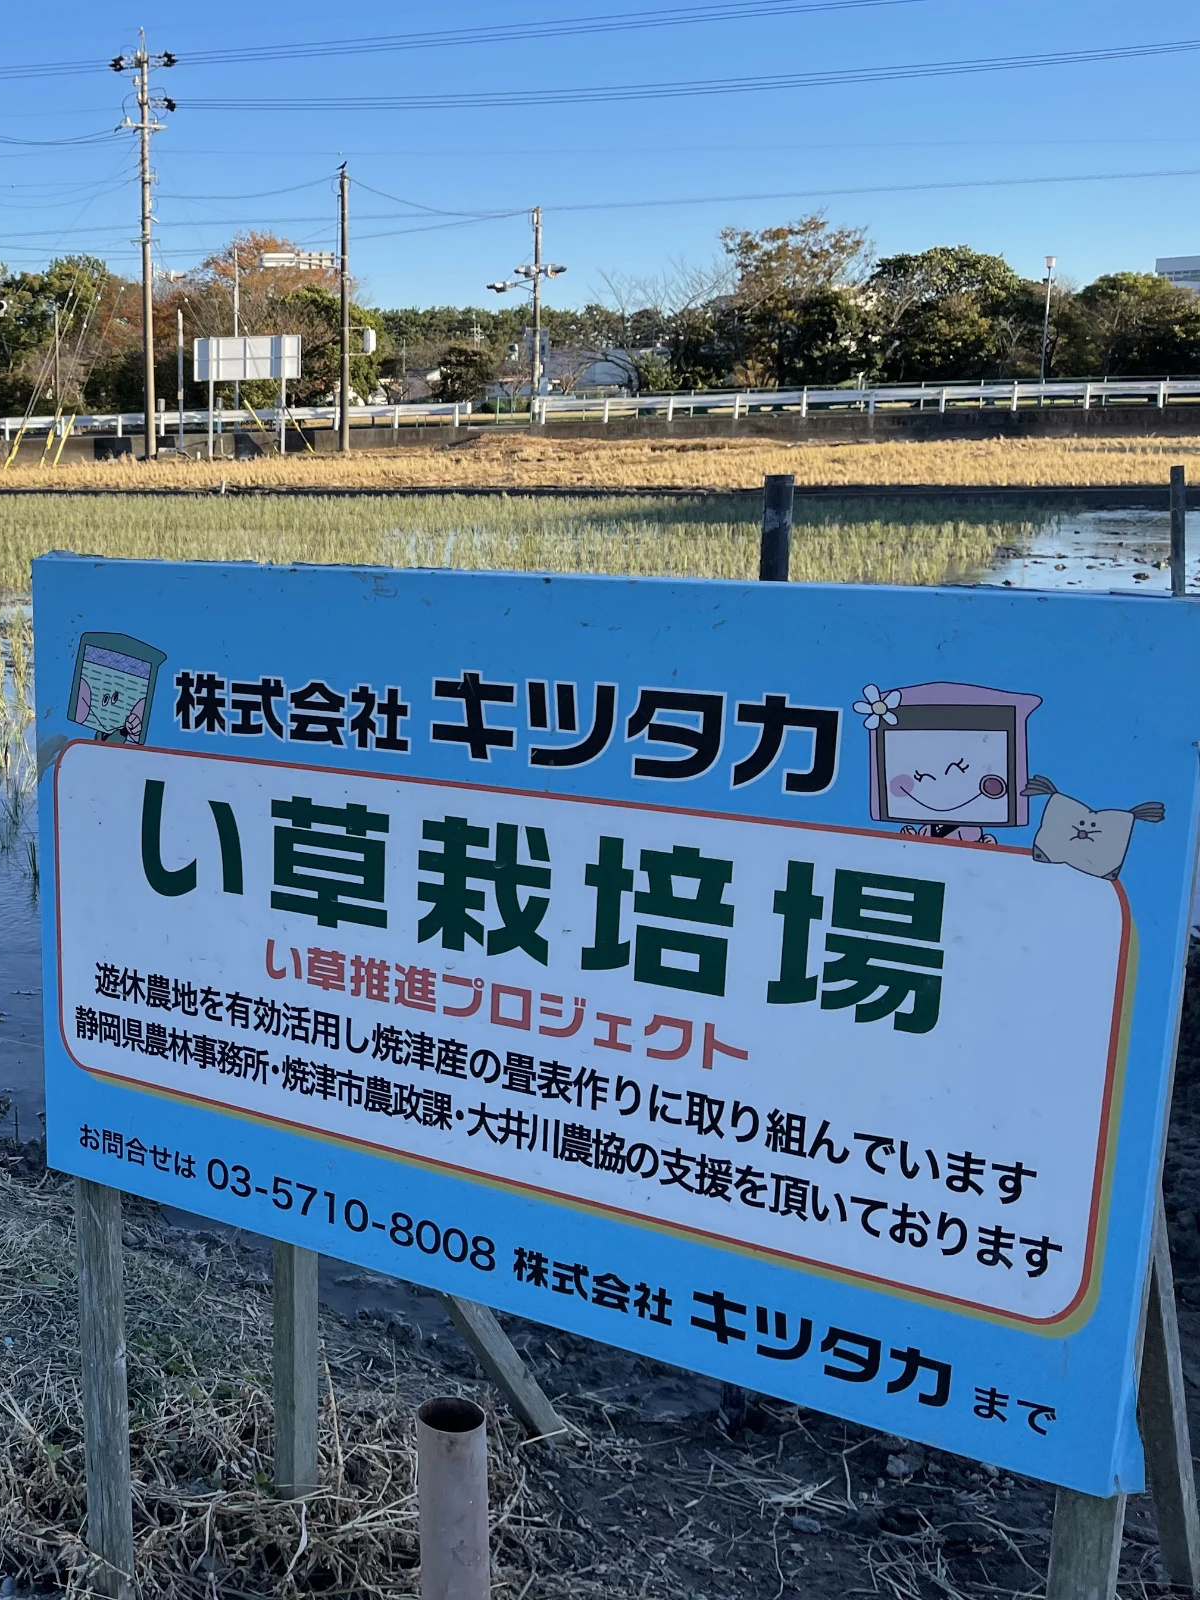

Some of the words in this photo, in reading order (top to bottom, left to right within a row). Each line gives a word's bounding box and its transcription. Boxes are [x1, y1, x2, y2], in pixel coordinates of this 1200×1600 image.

[175, 672, 410, 750] 株式会社
[432, 672, 838, 792] キツタカ
[141, 779, 945, 1033] い草栽培場
[266, 939, 749, 1070] い草推進プロジェクト
[95, 963, 1038, 1204] 遊休農地を有効活用し焼津産の畳表作りに取り組んでいます
[79, 1124, 196, 1180] お問合せは
[207, 1158, 496, 1272] 03-5710-8008
[513, 1246, 673, 1327] 株式会社
[689, 1291, 953, 1408] キツタカ
[972, 1387, 1057, 1437] まで
